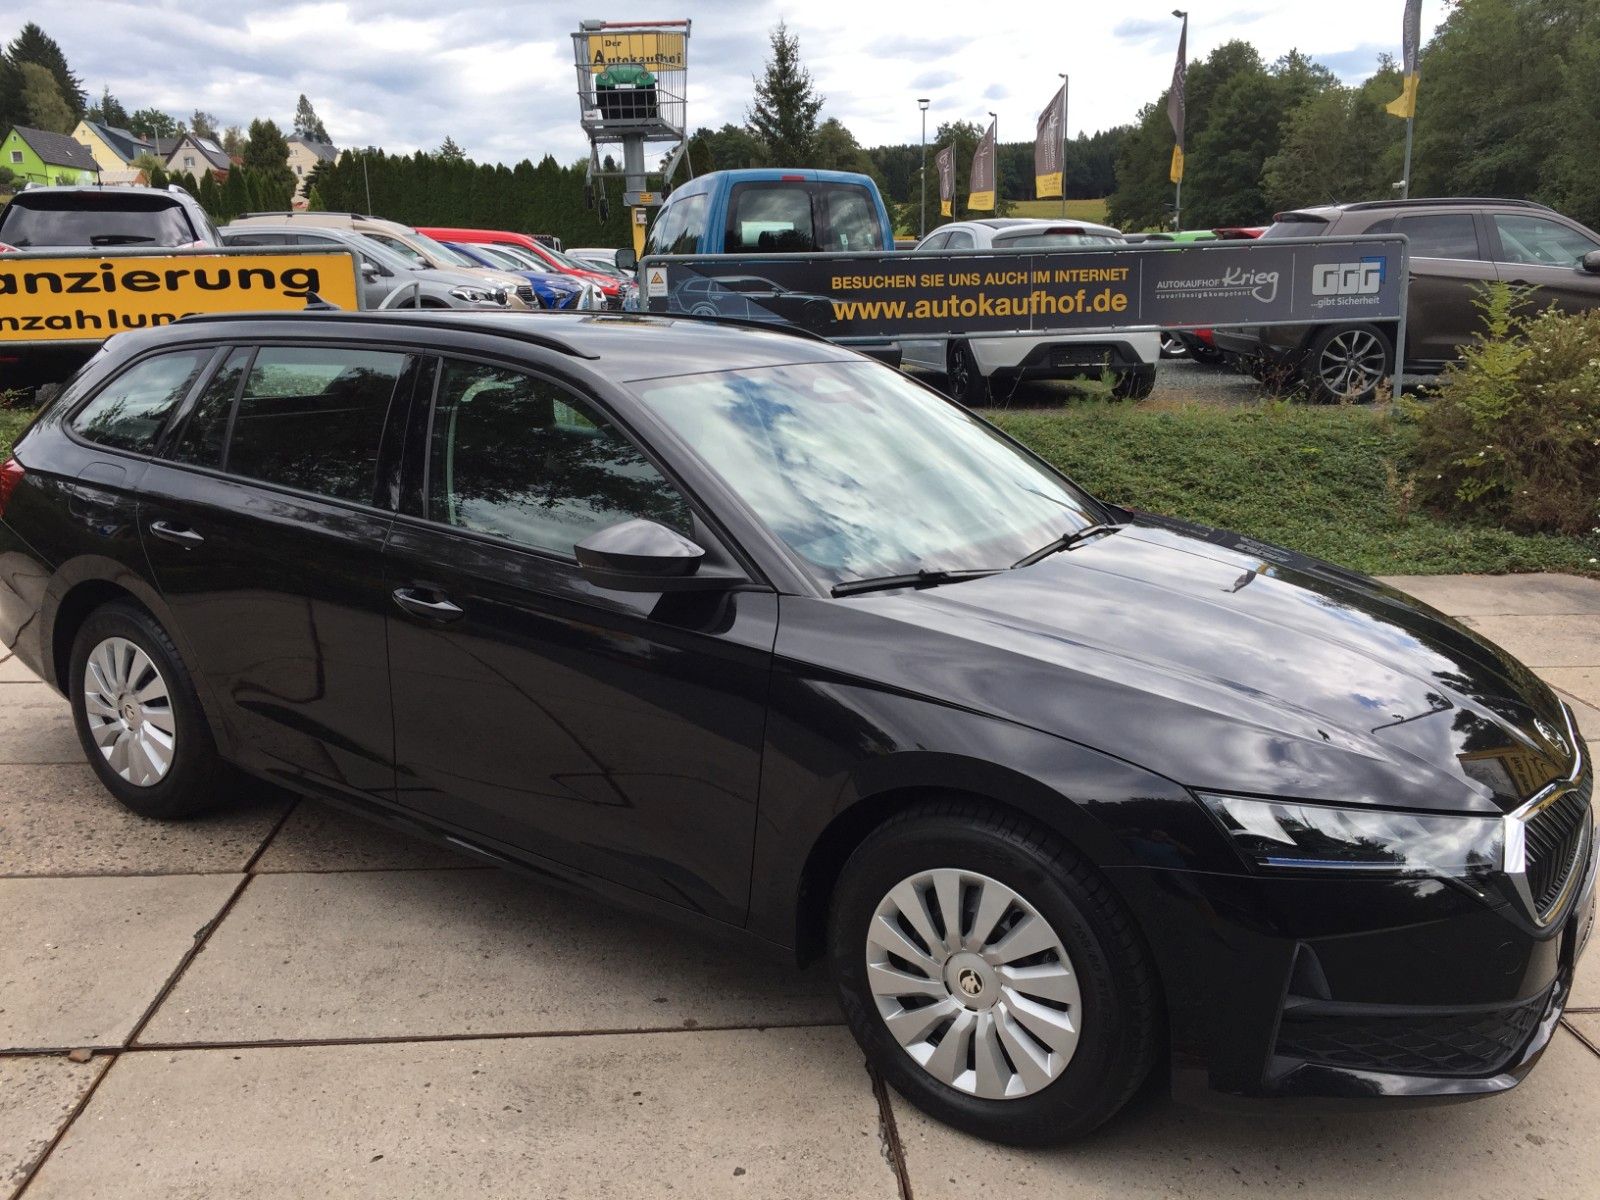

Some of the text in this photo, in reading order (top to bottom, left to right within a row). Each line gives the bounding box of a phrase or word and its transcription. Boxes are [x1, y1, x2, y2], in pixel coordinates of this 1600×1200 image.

[605, 39, 622, 47] Der
[831, 268, 1129, 290] BESUCHEN SIE UNS AUCH IM INTERNET
[1156, 266, 1280, 304] AUTOKAUFHOF Krieg
[1311, 261, 1381, 296] GGG
[832, 288, 1128, 321] www.autokaufhof.de
[1336, 295, 1380, 306] Sicherheit
[0, 308, 203, 331] nzahlun
